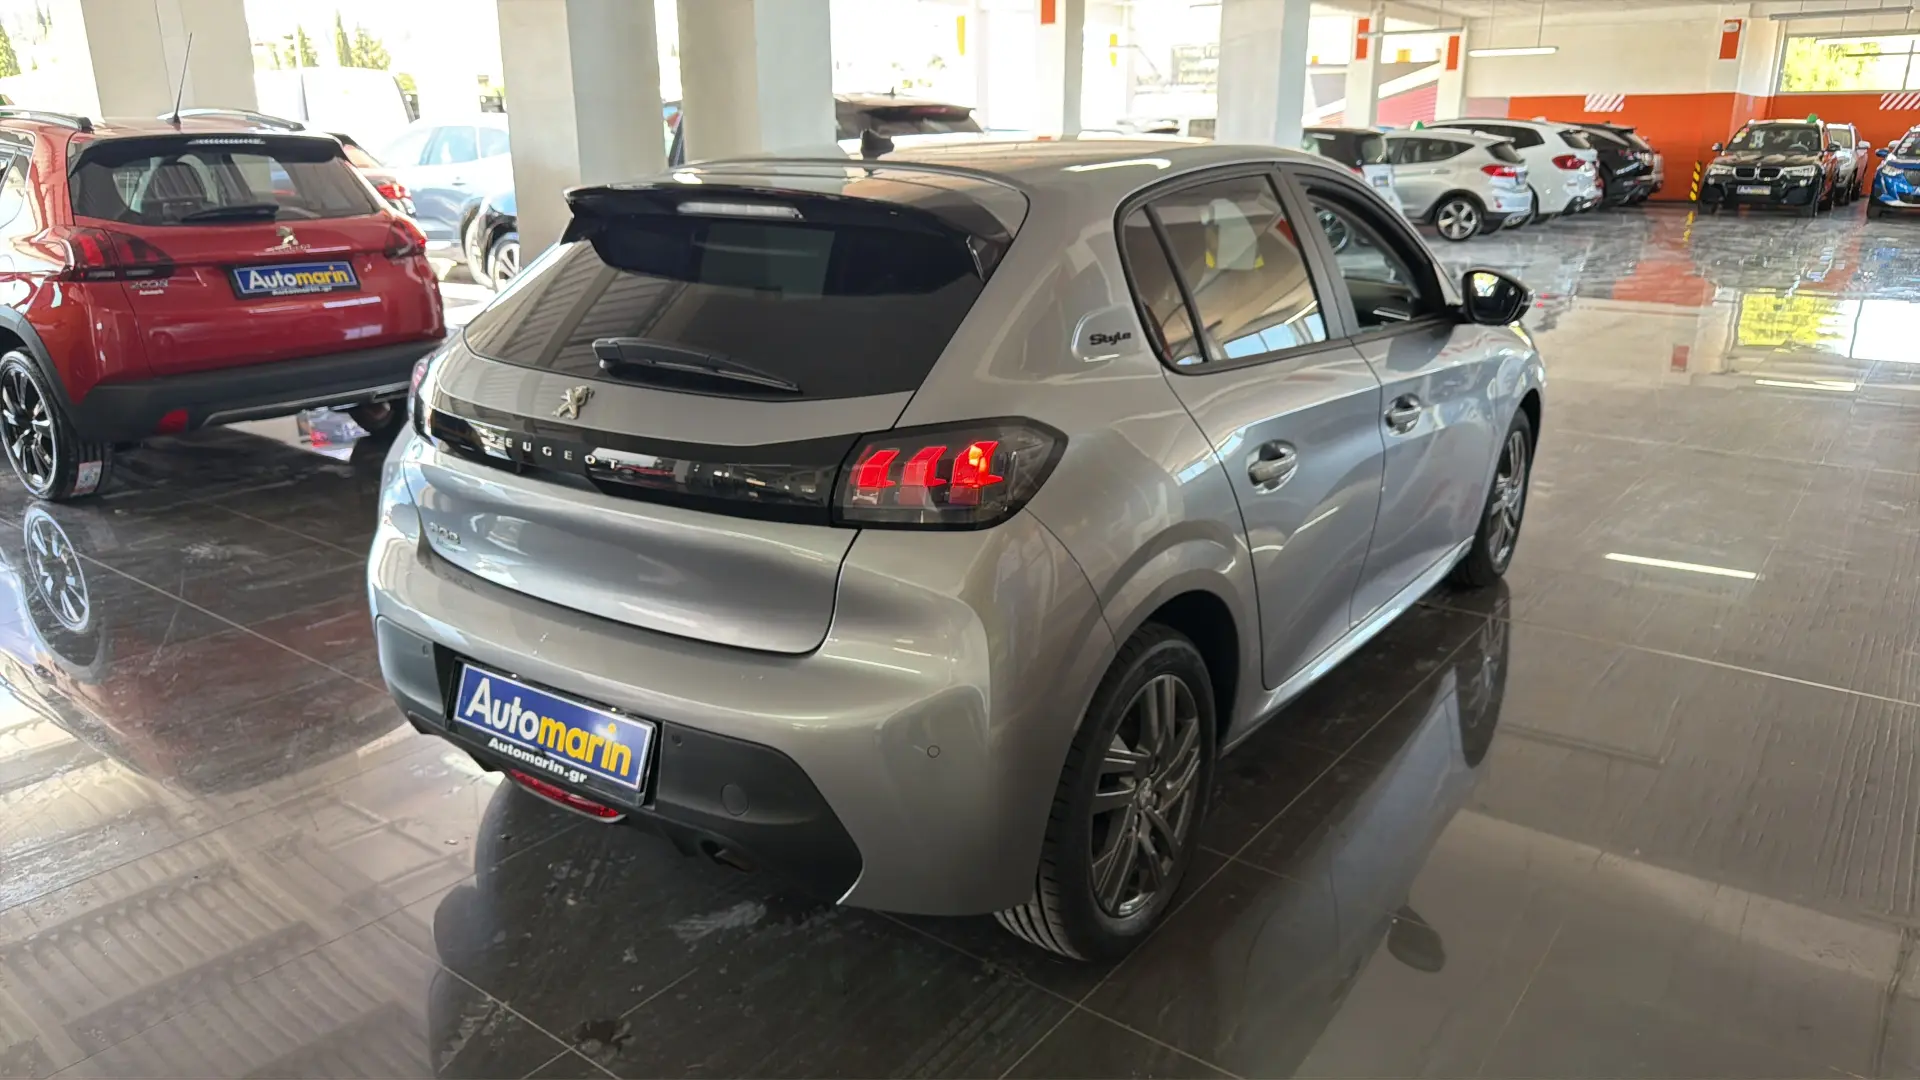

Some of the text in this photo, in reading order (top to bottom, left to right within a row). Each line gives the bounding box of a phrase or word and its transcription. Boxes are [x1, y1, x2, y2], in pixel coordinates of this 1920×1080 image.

[249, 265, 350, 290] Automarin
[1089, 331, 1132, 346] Style
[465, 677, 632, 777] Automarin
[488, 737, 588, 783] Automarin.gr
